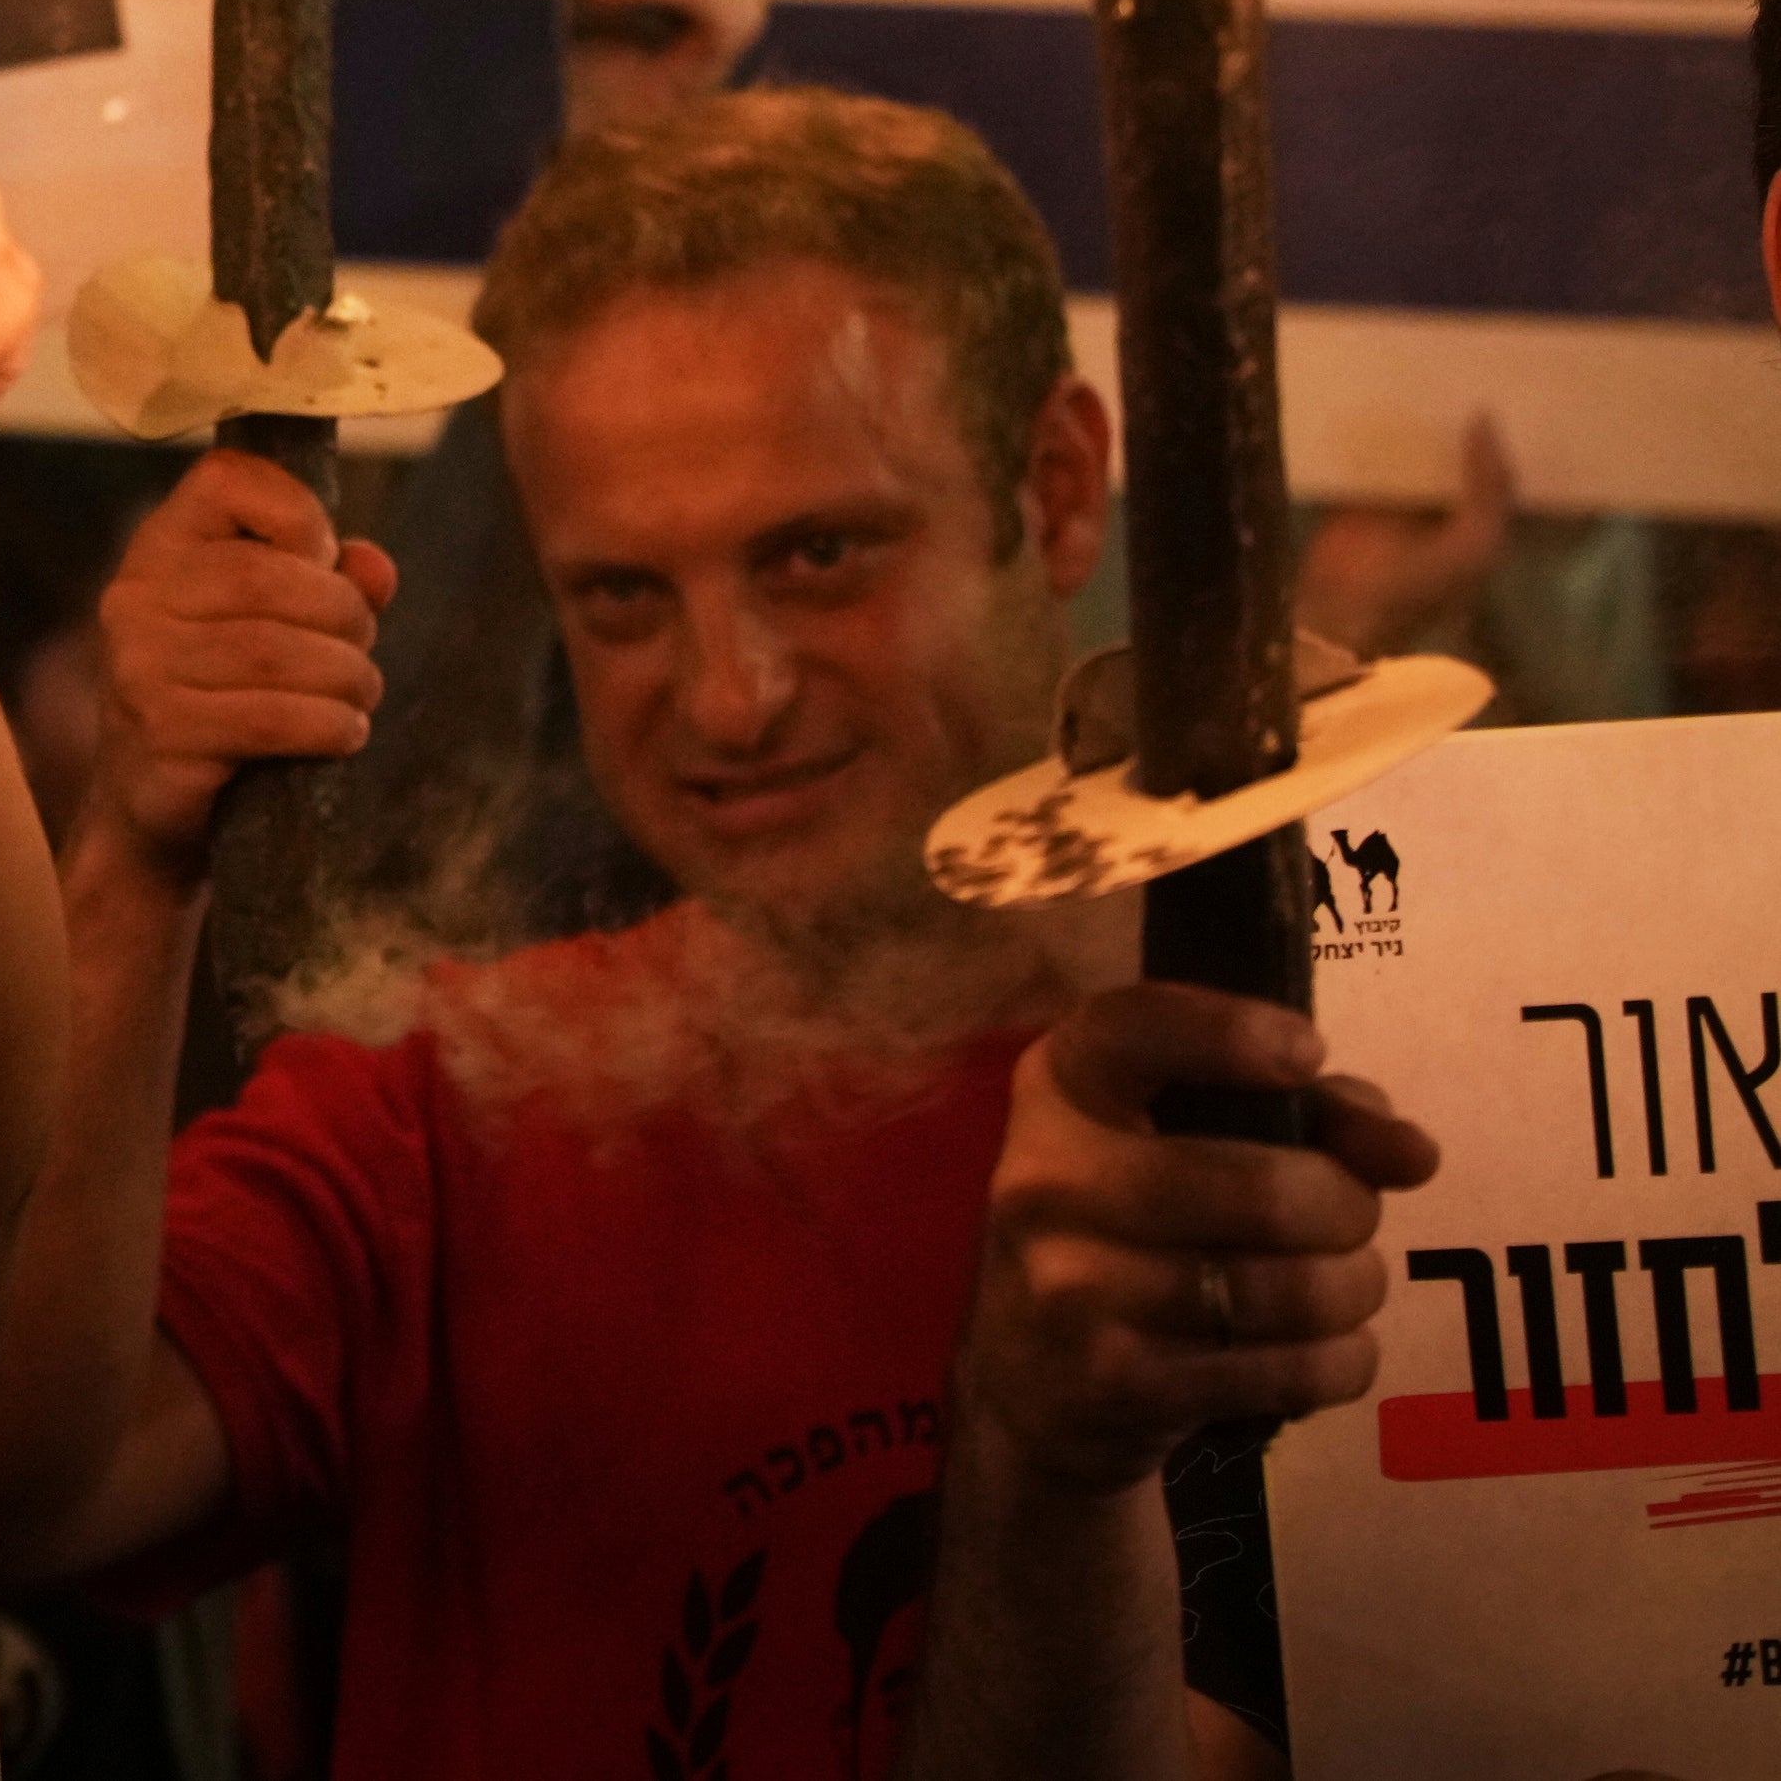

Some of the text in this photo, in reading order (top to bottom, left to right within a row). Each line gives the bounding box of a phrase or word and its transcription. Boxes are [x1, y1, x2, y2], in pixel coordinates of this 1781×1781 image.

[1354, 918, 1402, 936] קיבוץ
[1370, 939, 1404, 957] ניר
[1407, 1201, 1781, 1422] חזור
